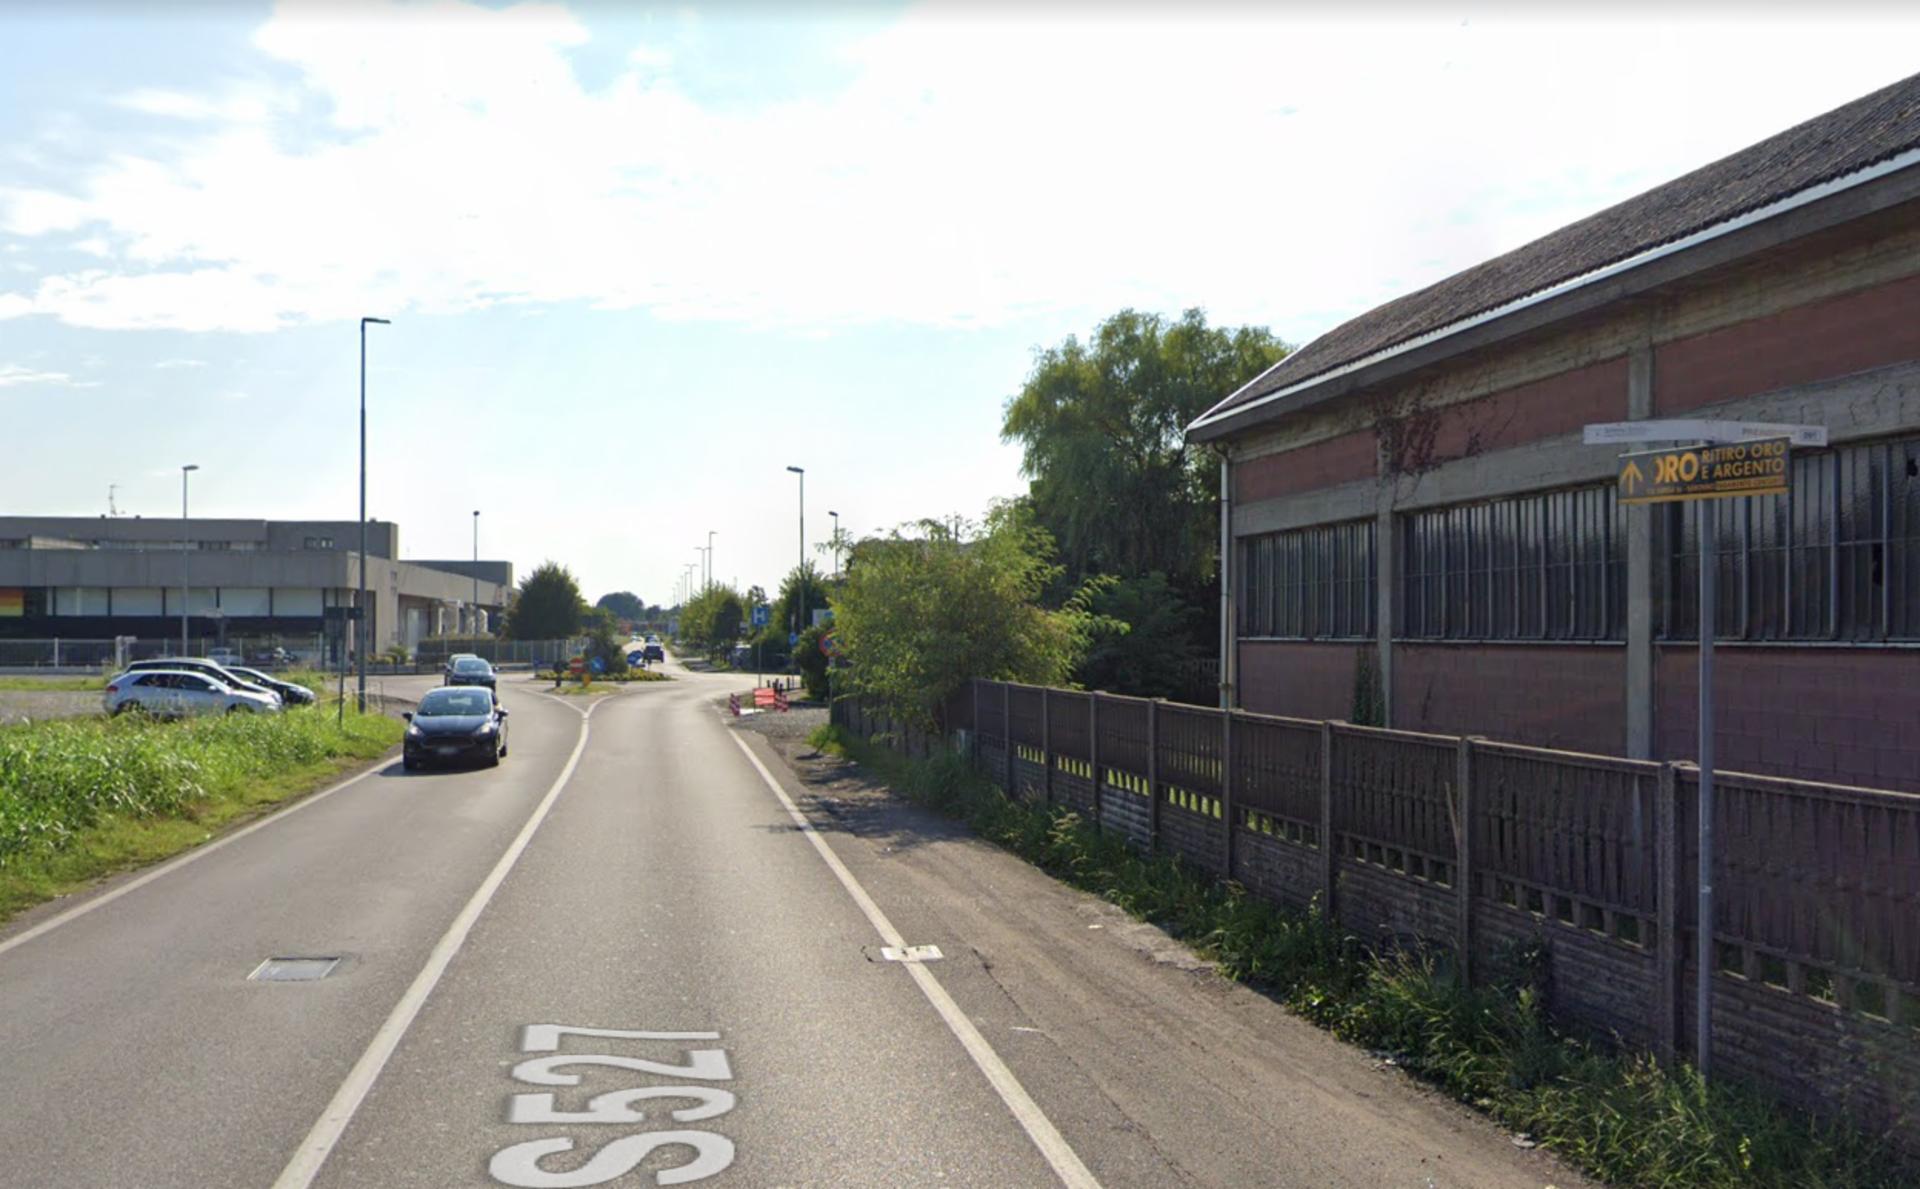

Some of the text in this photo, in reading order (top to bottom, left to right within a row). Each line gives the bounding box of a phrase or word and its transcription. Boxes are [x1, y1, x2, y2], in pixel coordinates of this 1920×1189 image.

[1701, 441, 1785, 463] RITIRO ORO
[1701, 457, 1785, 480] E ARGENTO
[753, 609, 765, 624] H
